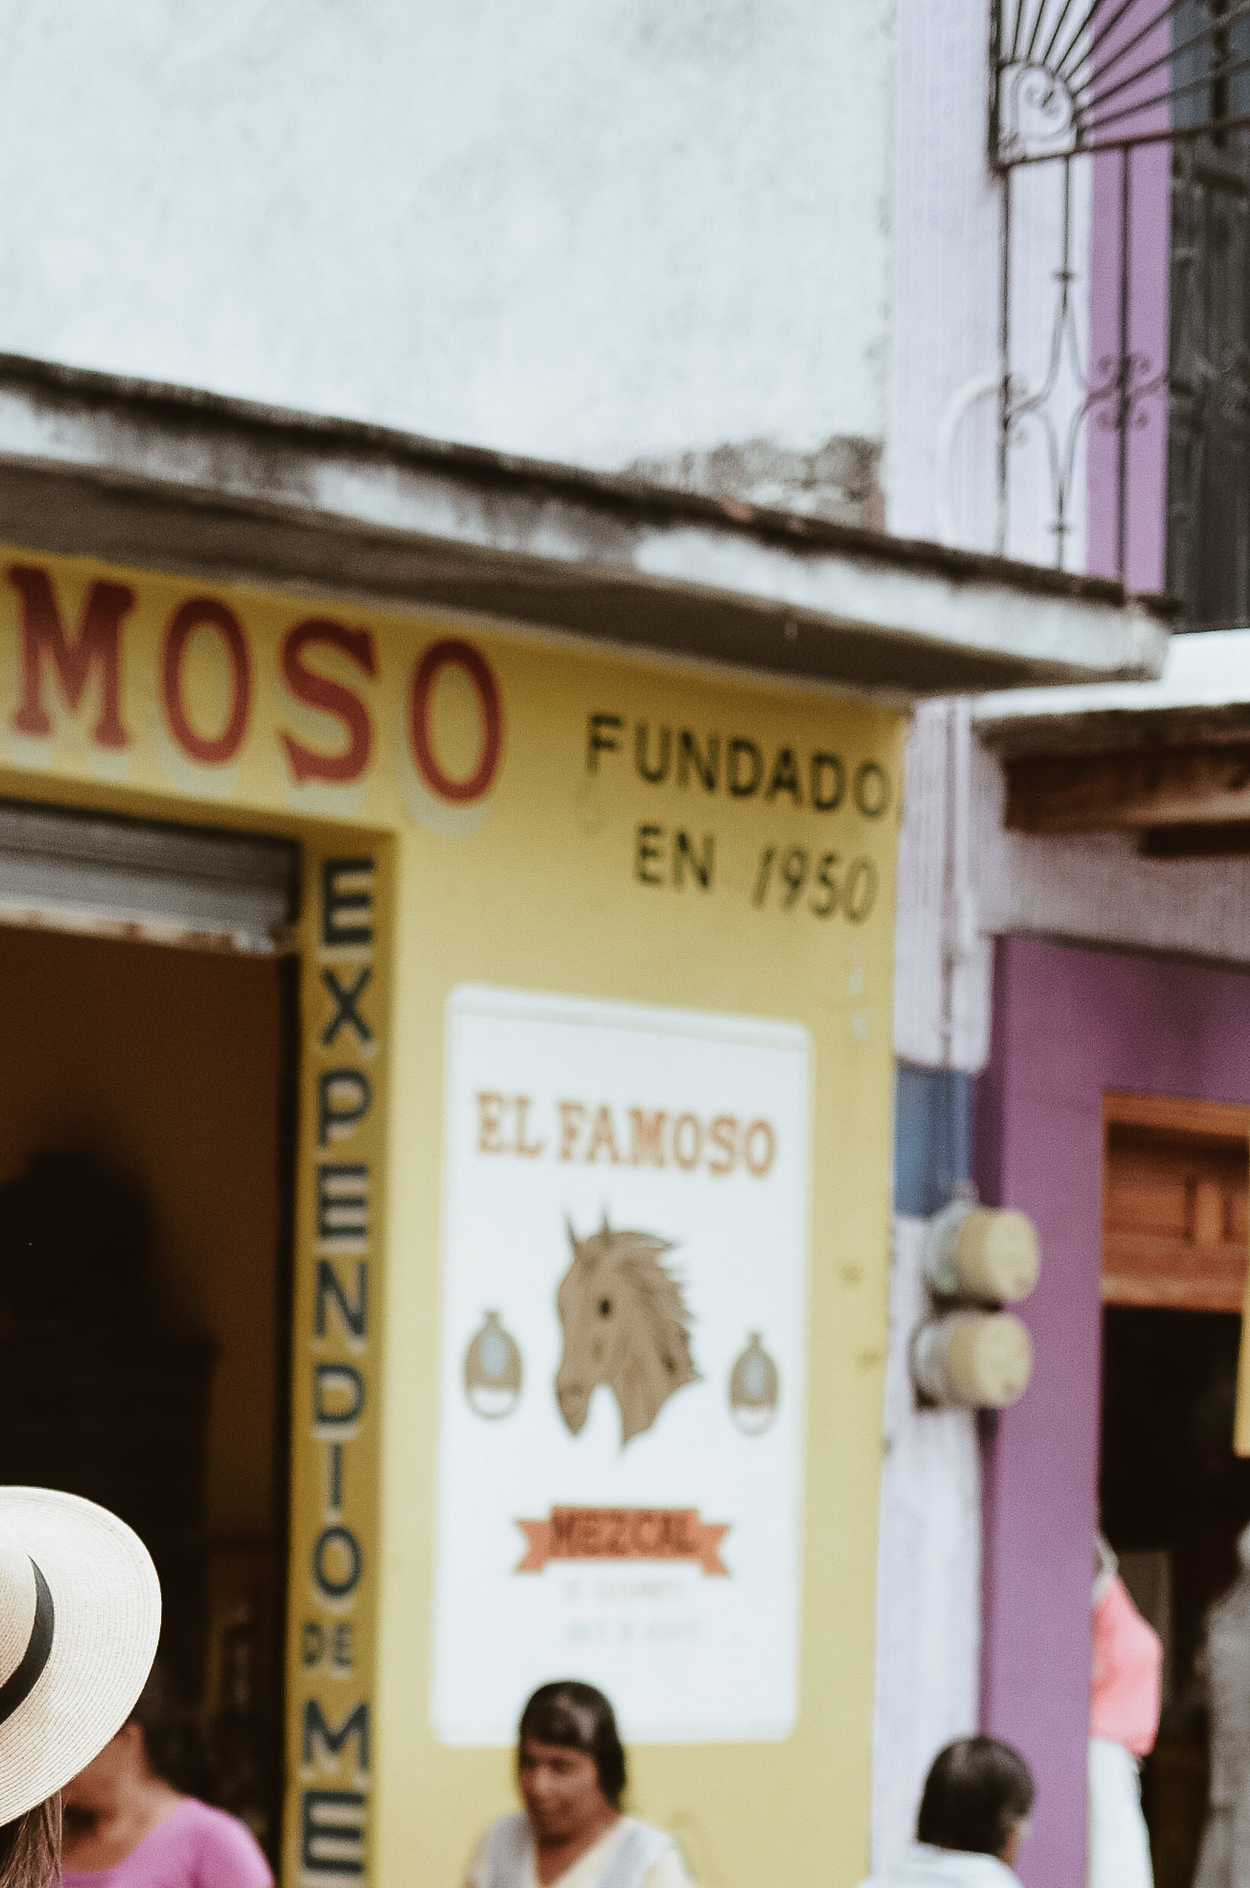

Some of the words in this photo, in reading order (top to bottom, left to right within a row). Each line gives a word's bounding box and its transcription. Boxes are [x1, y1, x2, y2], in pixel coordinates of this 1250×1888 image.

[586, 711, 892, 819] FUNDADO
[635, 822, 714, 892] EN
[751, 846, 879, 924] 1950
[474, 1090, 545, 1158] EL
[557, 1099, 776, 1178] FAMOSO
[309, 856, 376, 1600] EXPENDIO
[552, 1509, 698, 1556] MEZCAL
[302, 1622, 353, 1668] DE
